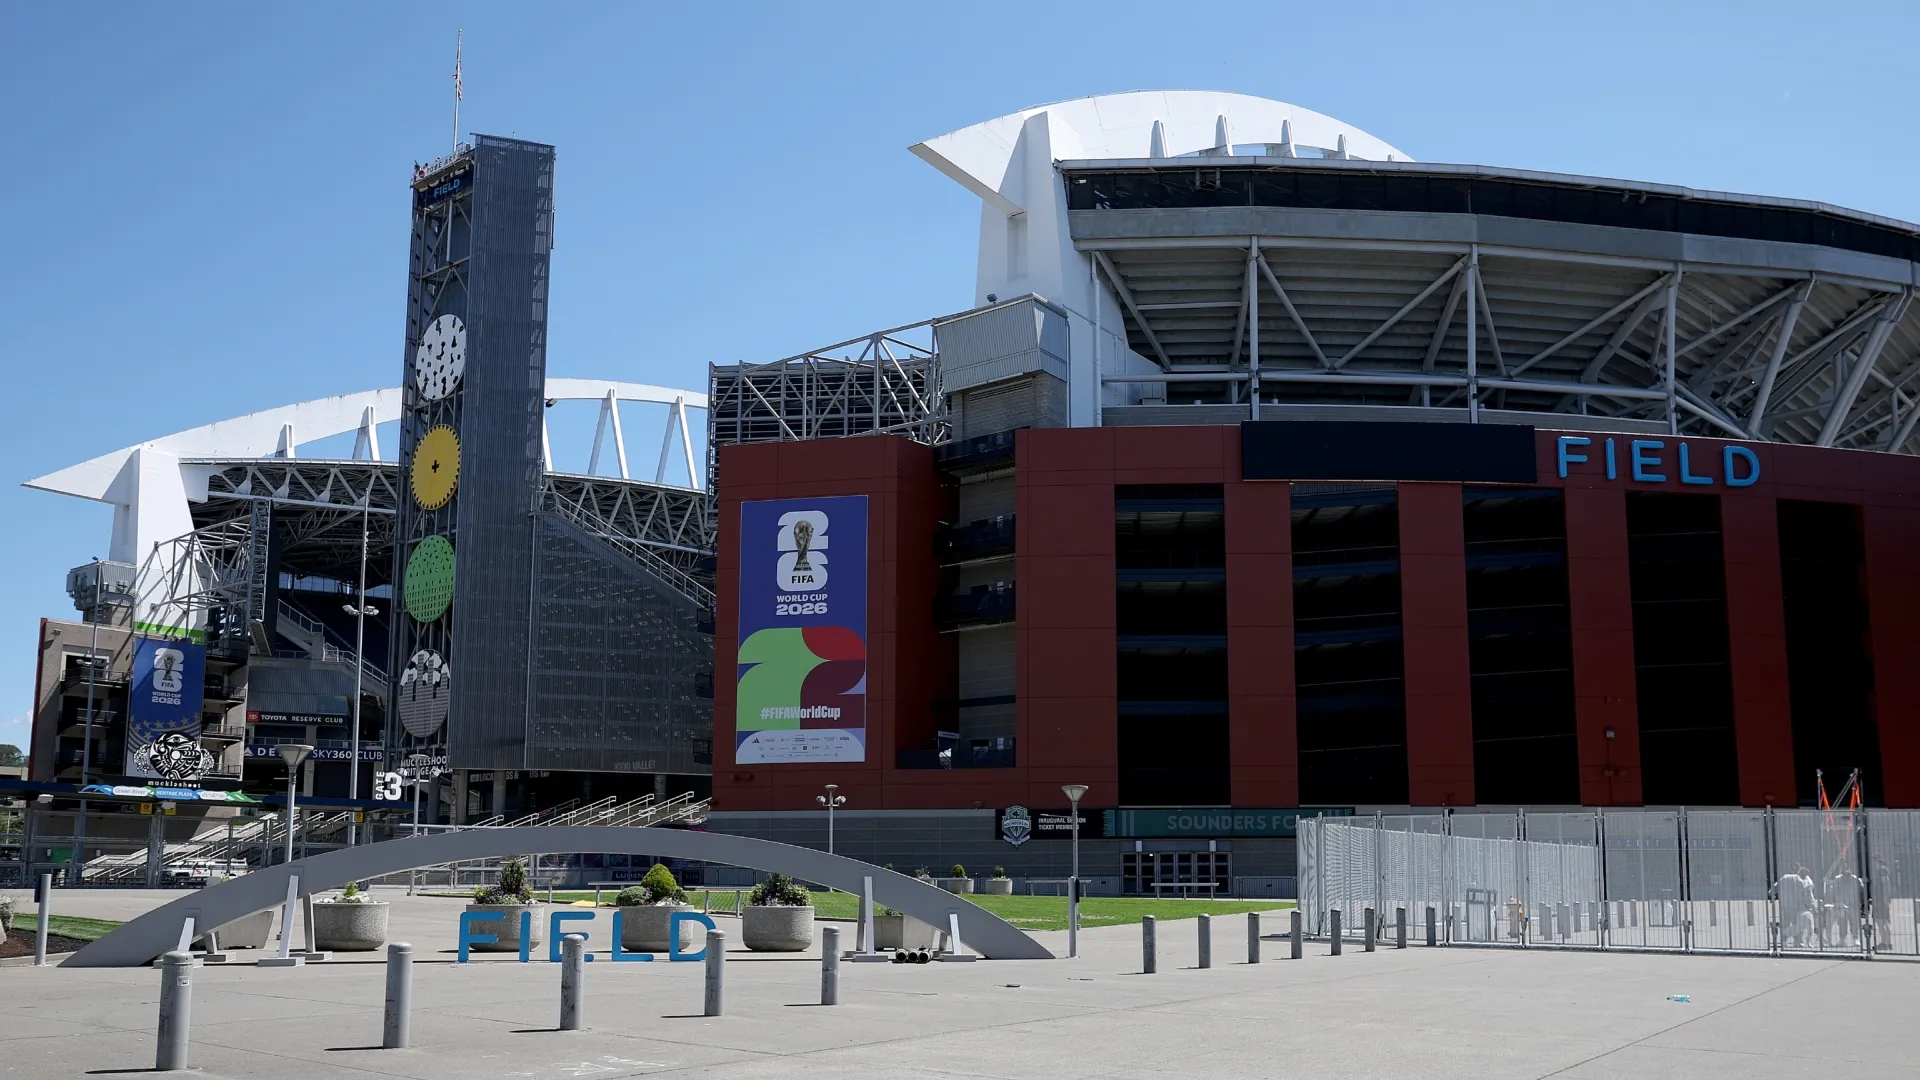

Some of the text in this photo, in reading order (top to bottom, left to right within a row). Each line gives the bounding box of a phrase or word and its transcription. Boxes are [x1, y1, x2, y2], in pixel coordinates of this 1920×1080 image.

[434, 179, 460, 198] FIELD
[1556, 436, 1760, 487] FIELD
[791, 575, 815, 585] FIFA
[777, 594, 828, 603] WORLD CUP
[776, 603, 828, 616] 2026
[152, 697, 181, 705] 2026
[760, 705, 841, 720] #FIFAWorldCup
[313, 749, 383, 760] SKY360 CLUB
[375, 771, 385, 801] GATE
[384, 772, 403, 801] 3
[1167, 816, 1296, 830] SOUNDERS FC
[457, 911, 717, 963] FIELD
